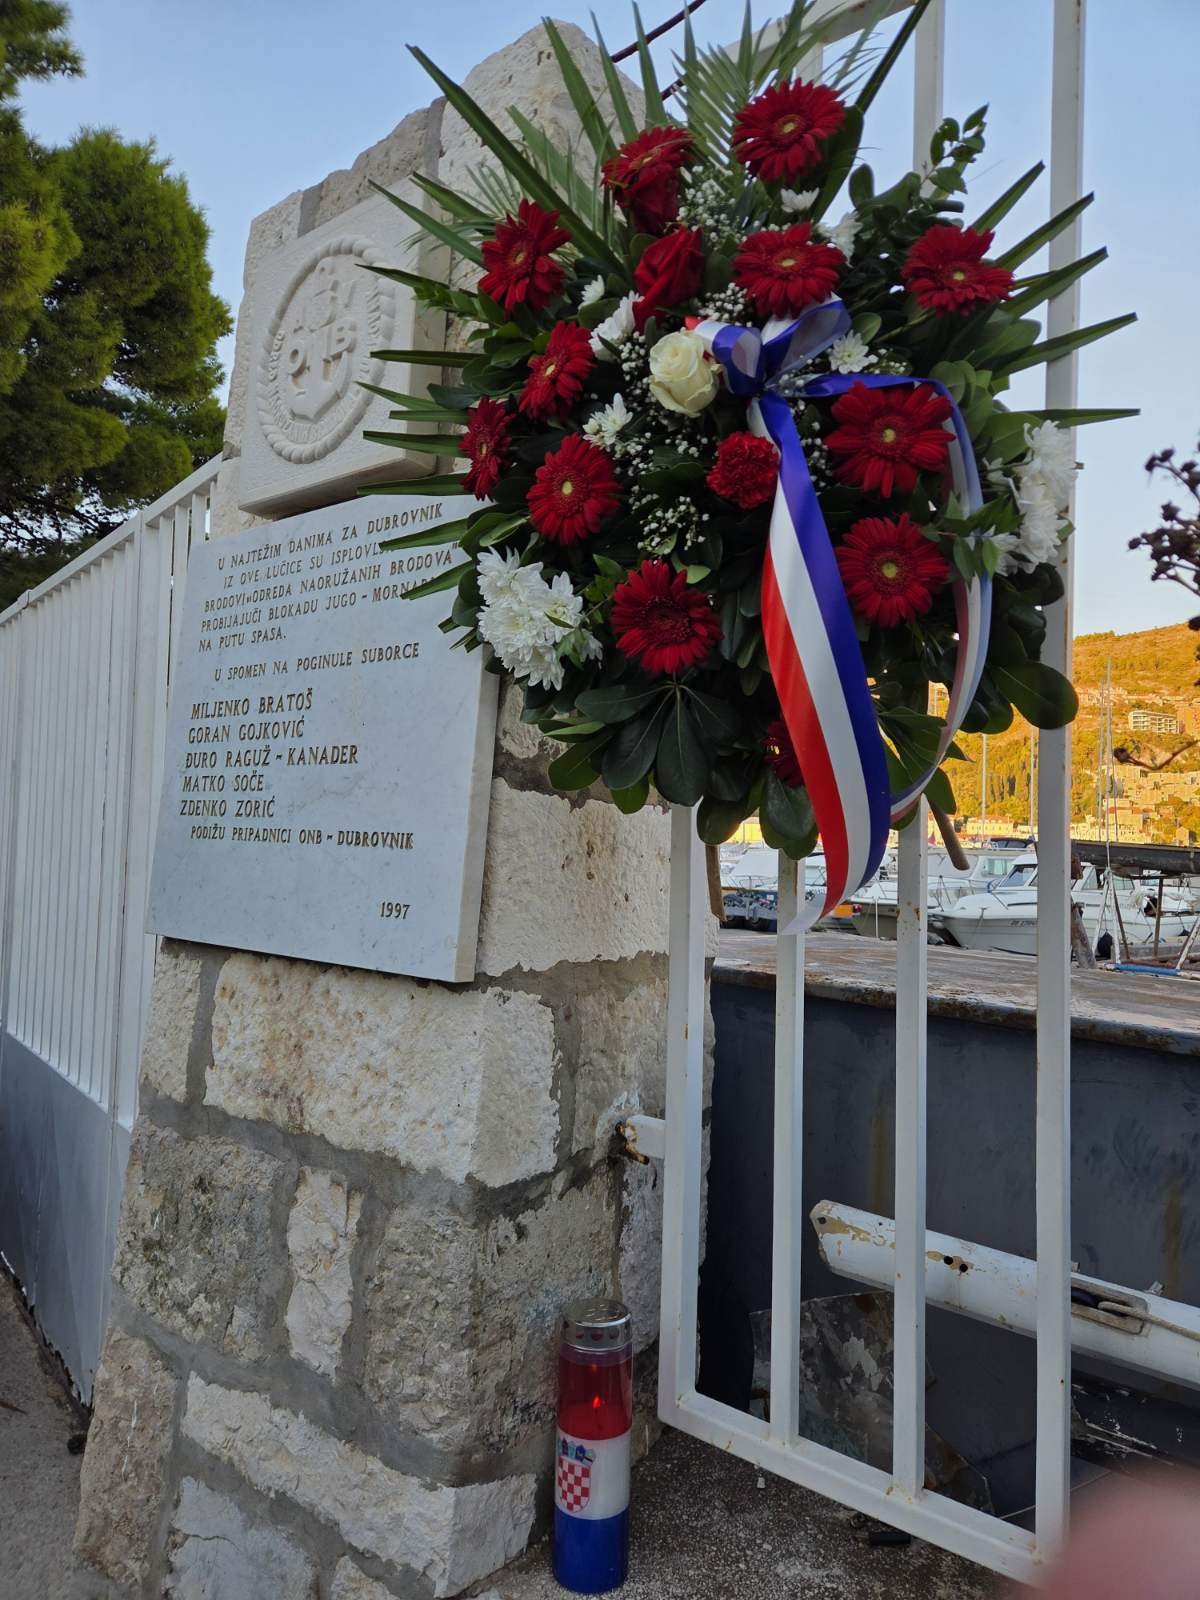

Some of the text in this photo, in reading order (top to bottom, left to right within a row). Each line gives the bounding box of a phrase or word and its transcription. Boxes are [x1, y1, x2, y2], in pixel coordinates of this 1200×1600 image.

[218, 502, 443, 571] U NAJTEŽIM DANIMA ZA DUBROVNIK
[223, 576, 233, 590] IZ
[240, 570, 259, 585] OVE
[266, 559, 302, 580] LUČICE
[309, 555, 323, 570] SU
[204, 592, 246, 613] BRODOVI
[300, 564, 381, 595] NAORUŽANIH
[268, 599, 319, 621] BLOKADU
[326, 592, 357, 610] JUGO
[198, 626, 287, 653] NA PUTU SPASA.
[214, 642, 420, 682] U SPOMEN NA POGINULE SUBORCE
[190, 688, 313, 720] MILJENKO BRATOŠ
[188, 716, 305, 745] GORAN GOJKOVIĆ
[184, 752, 218, 769] ĐURO
[225, 744, 271, 767] RAGUŽ
[287, 744, 359, 766] KANADER
[182, 769, 265, 793] MATKO SOČE
[179, 796, 276, 818] ZDENKO ZORIĆ
[190, 823, 225, 840] PODIŽU
[231, 827, 292, 844] PRIPADNICI
[299, 829, 322, 845] ONB
[337, 830, 414, 849] DUBROVNIK
[380, 901, 411, 920] 1997
